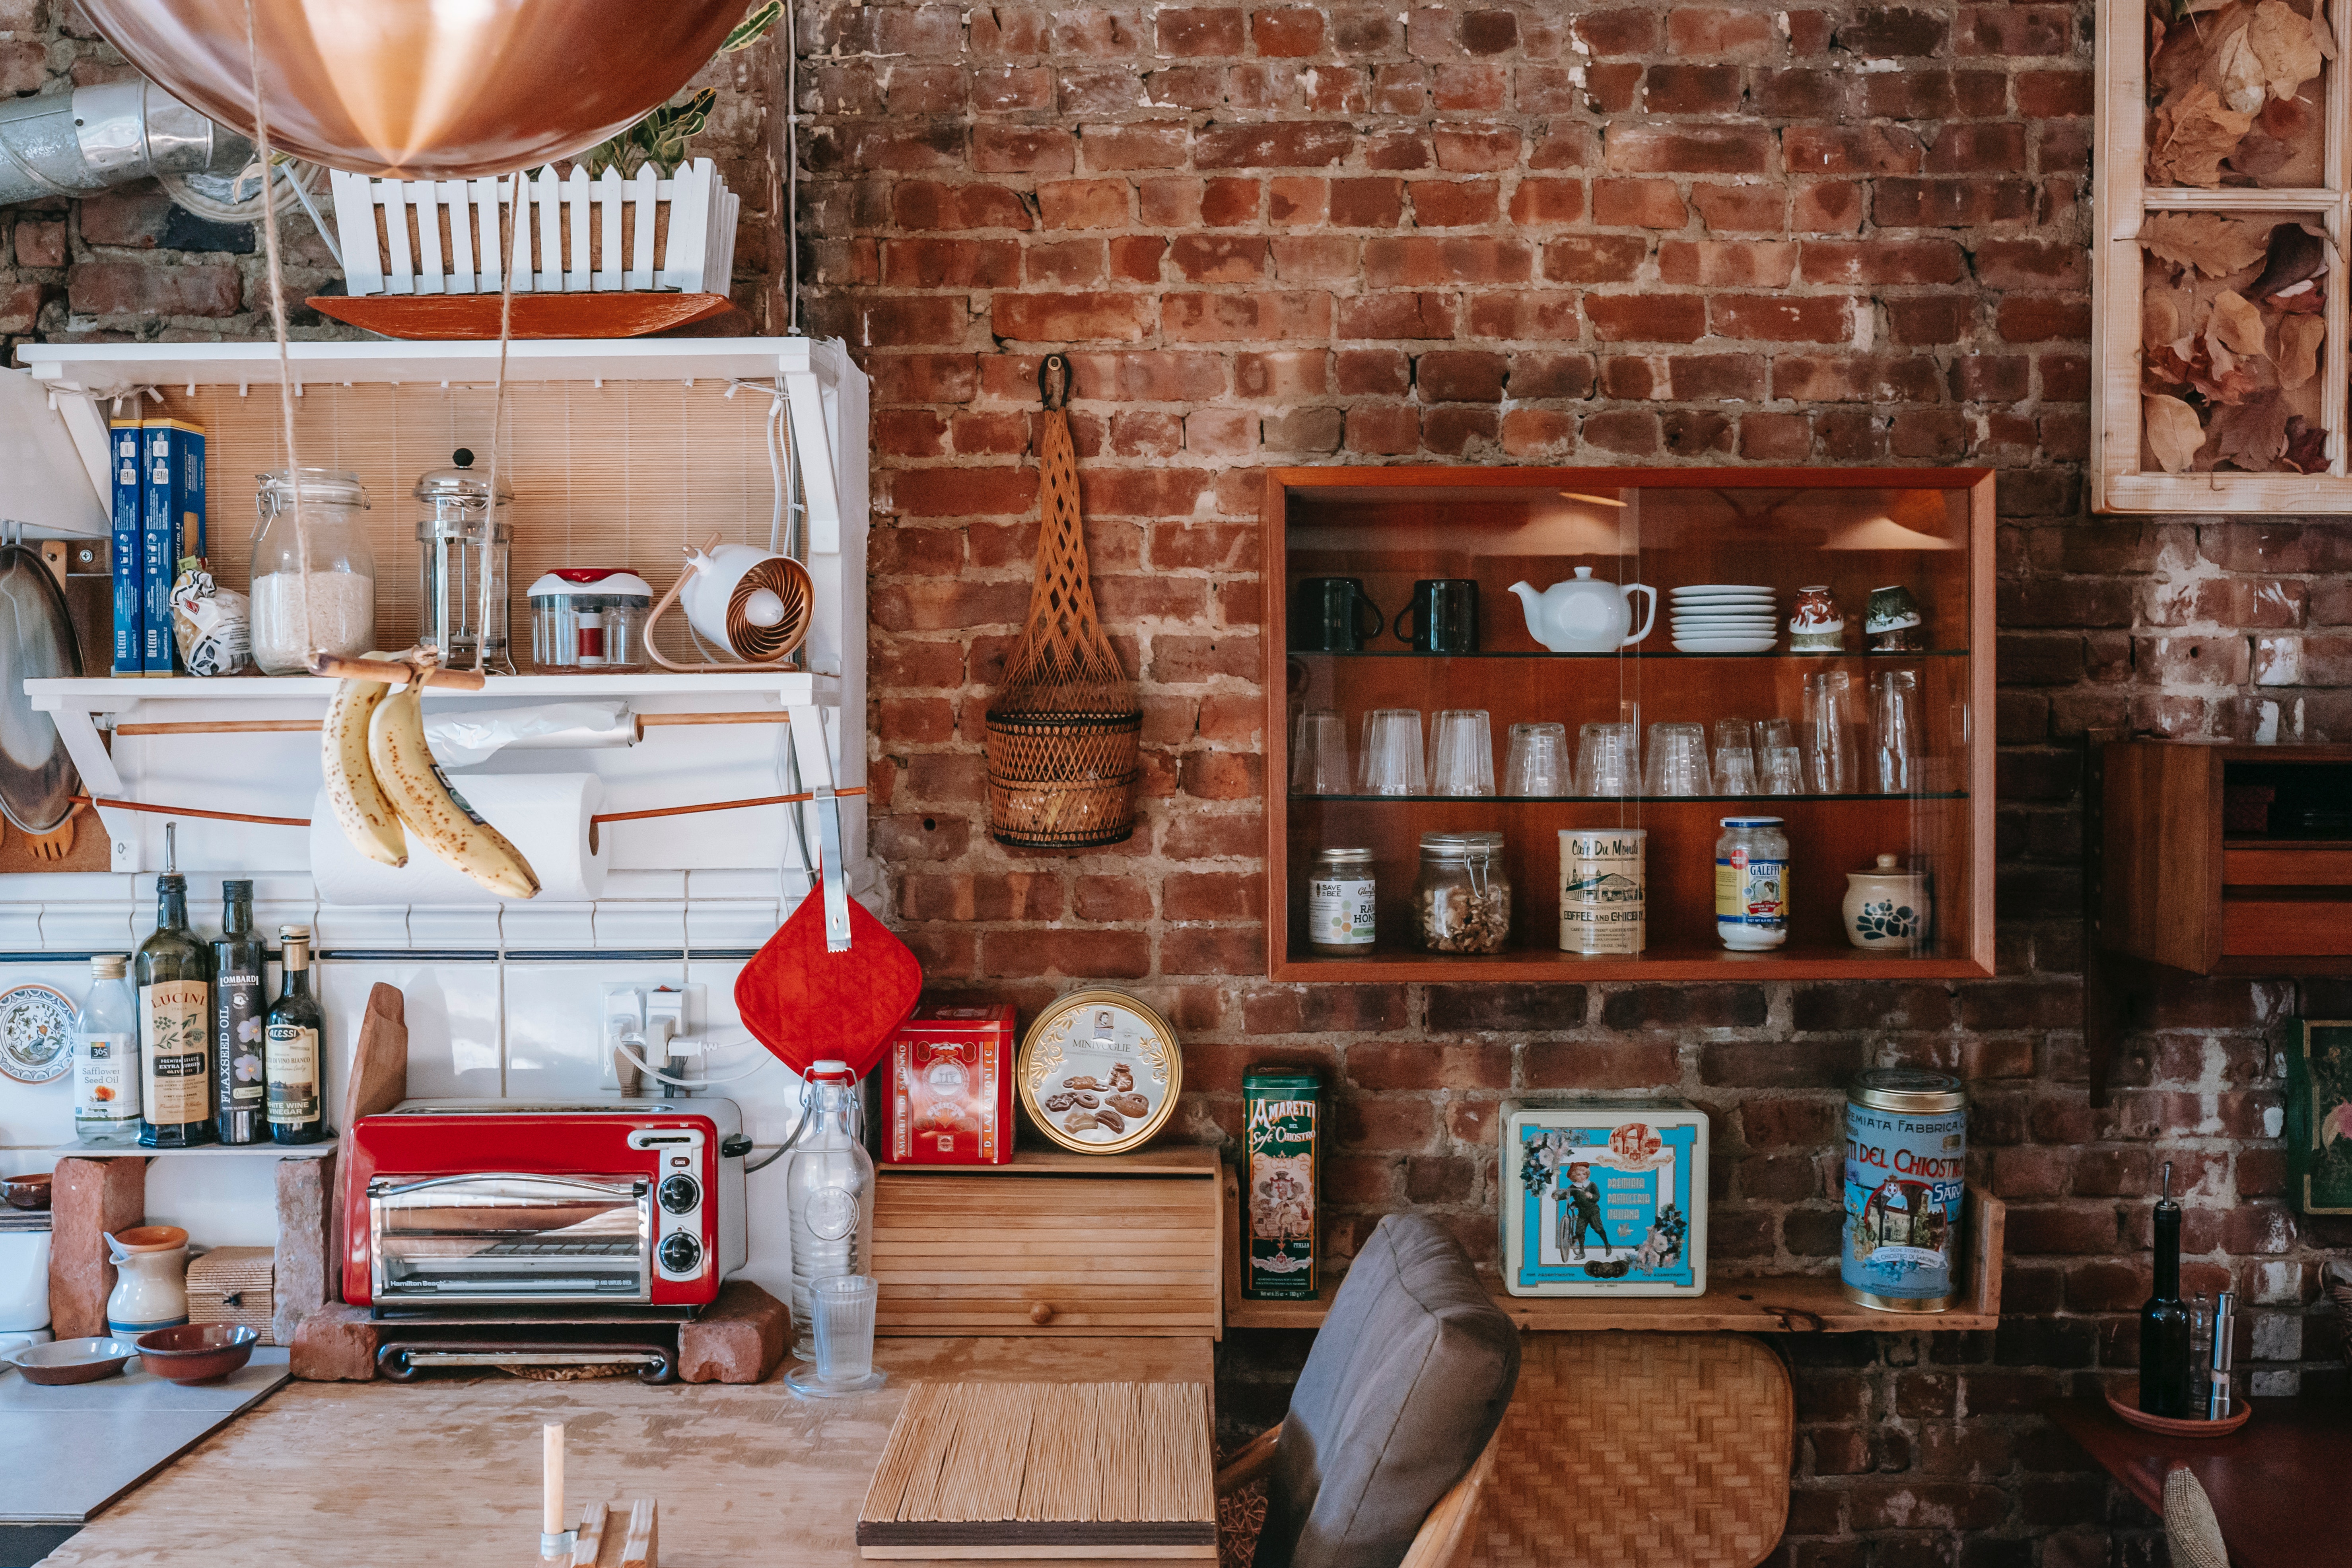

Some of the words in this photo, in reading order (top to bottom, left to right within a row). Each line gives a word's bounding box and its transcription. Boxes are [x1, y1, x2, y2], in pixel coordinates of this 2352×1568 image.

[117, 630, 126, 649] CECCO
[147, 630, 157, 649] CECCO
[1594, 840, 1609, 856] Du
[1750, 865, 1780, 875] GALEFFI
[1564, 910, 1592, 921] COFFEE
[220, 975, 259, 987] LOMBARDI
[151, 993, 205, 1009] LUCINI
[220, 1006, 229, 1028] OIL
[269, 1029, 297, 1038] ALESSI
[1073, 1039, 1131, 1052] MINIVOGLIE
[93, 1048, 108, 1057] 365
[220, 1032, 231, 1104] FLAXSEED
[899, 1095, 906, 1105] DI
[984, 1068, 993, 1133] LAZZARONI
[1247, 1098, 1316, 1132] AMARETTI
[1898, 1119, 1958, 1133] FABBRICA
[984, 1137, 992, 1148] D.
[1248, 1126, 1277, 1153] Soft
[1275, 1126, 1316, 1143] CHIOSTRO
[1859, 1143, 1889, 1170] DEL
[1607, 1177, 1645, 1189] PREMIATA
[1607, 1193, 1650, 1205] PASTICCERIA
[1934, 1183, 1963, 1203] SARO
[1607, 1209, 1640, 1220] ITALIANA
[1916, 1254, 1938, 1266] SARONNO
